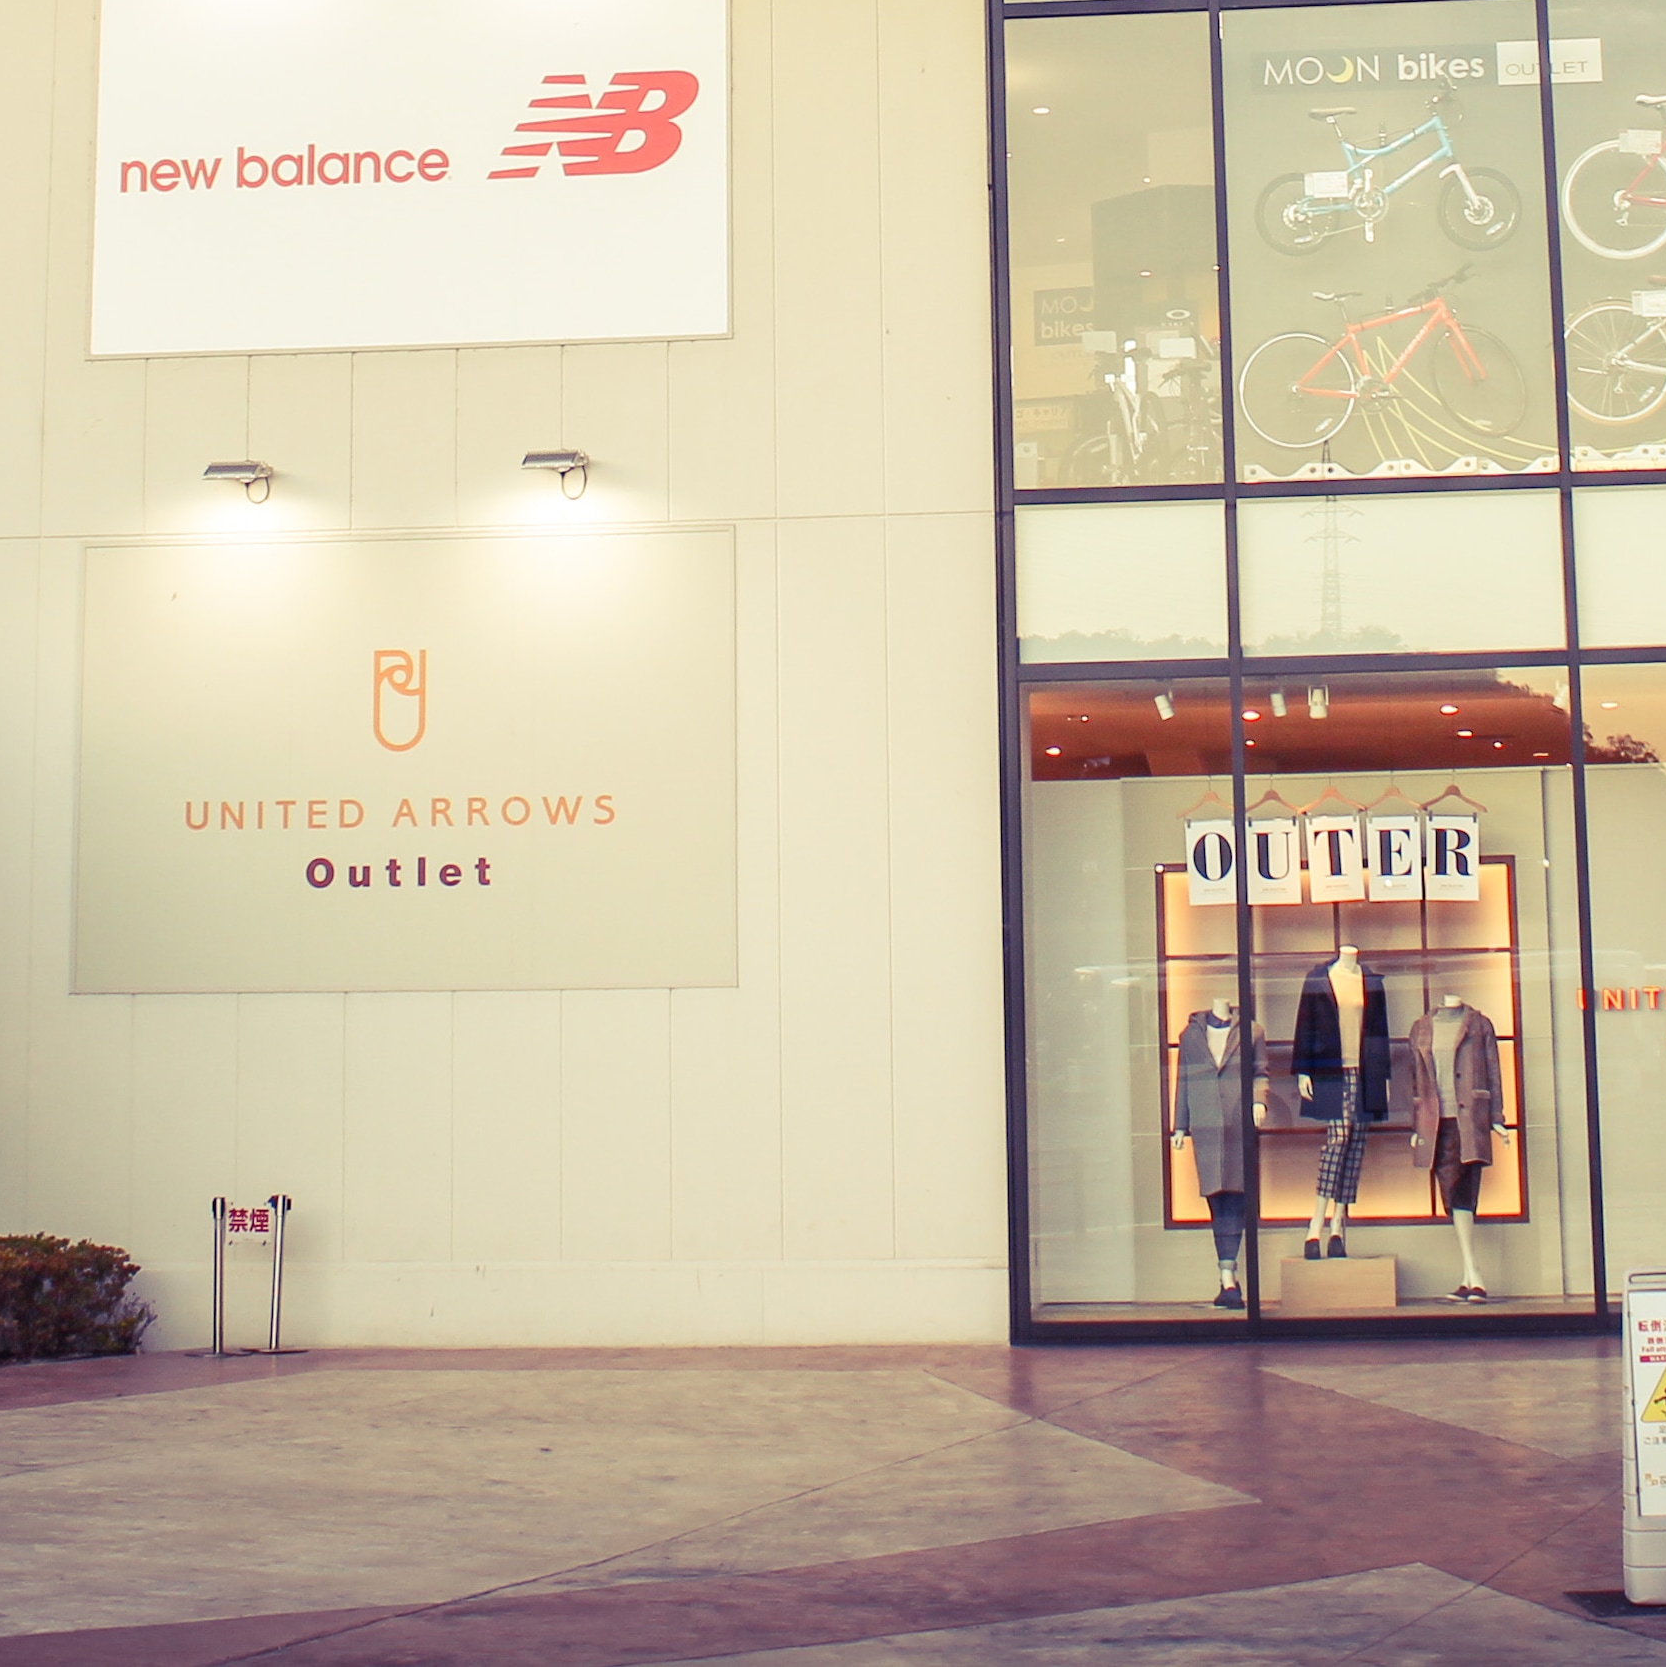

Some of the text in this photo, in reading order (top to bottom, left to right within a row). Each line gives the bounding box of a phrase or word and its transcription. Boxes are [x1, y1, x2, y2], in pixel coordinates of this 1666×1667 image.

[1397, 52, 1484, 81] bikes
[1505, 60, 1589, 77] OULET
[119, 143, 450, 193] new balance
[1041, 320, 1094, 339] bikes
[184, 794, 617, 831] UNITED ARROWS
[1193, 827, 1475, 882] OUTER
[305, 855, 492, 889] Outlet
[228, 1208, 270, 1233] 禁煙
